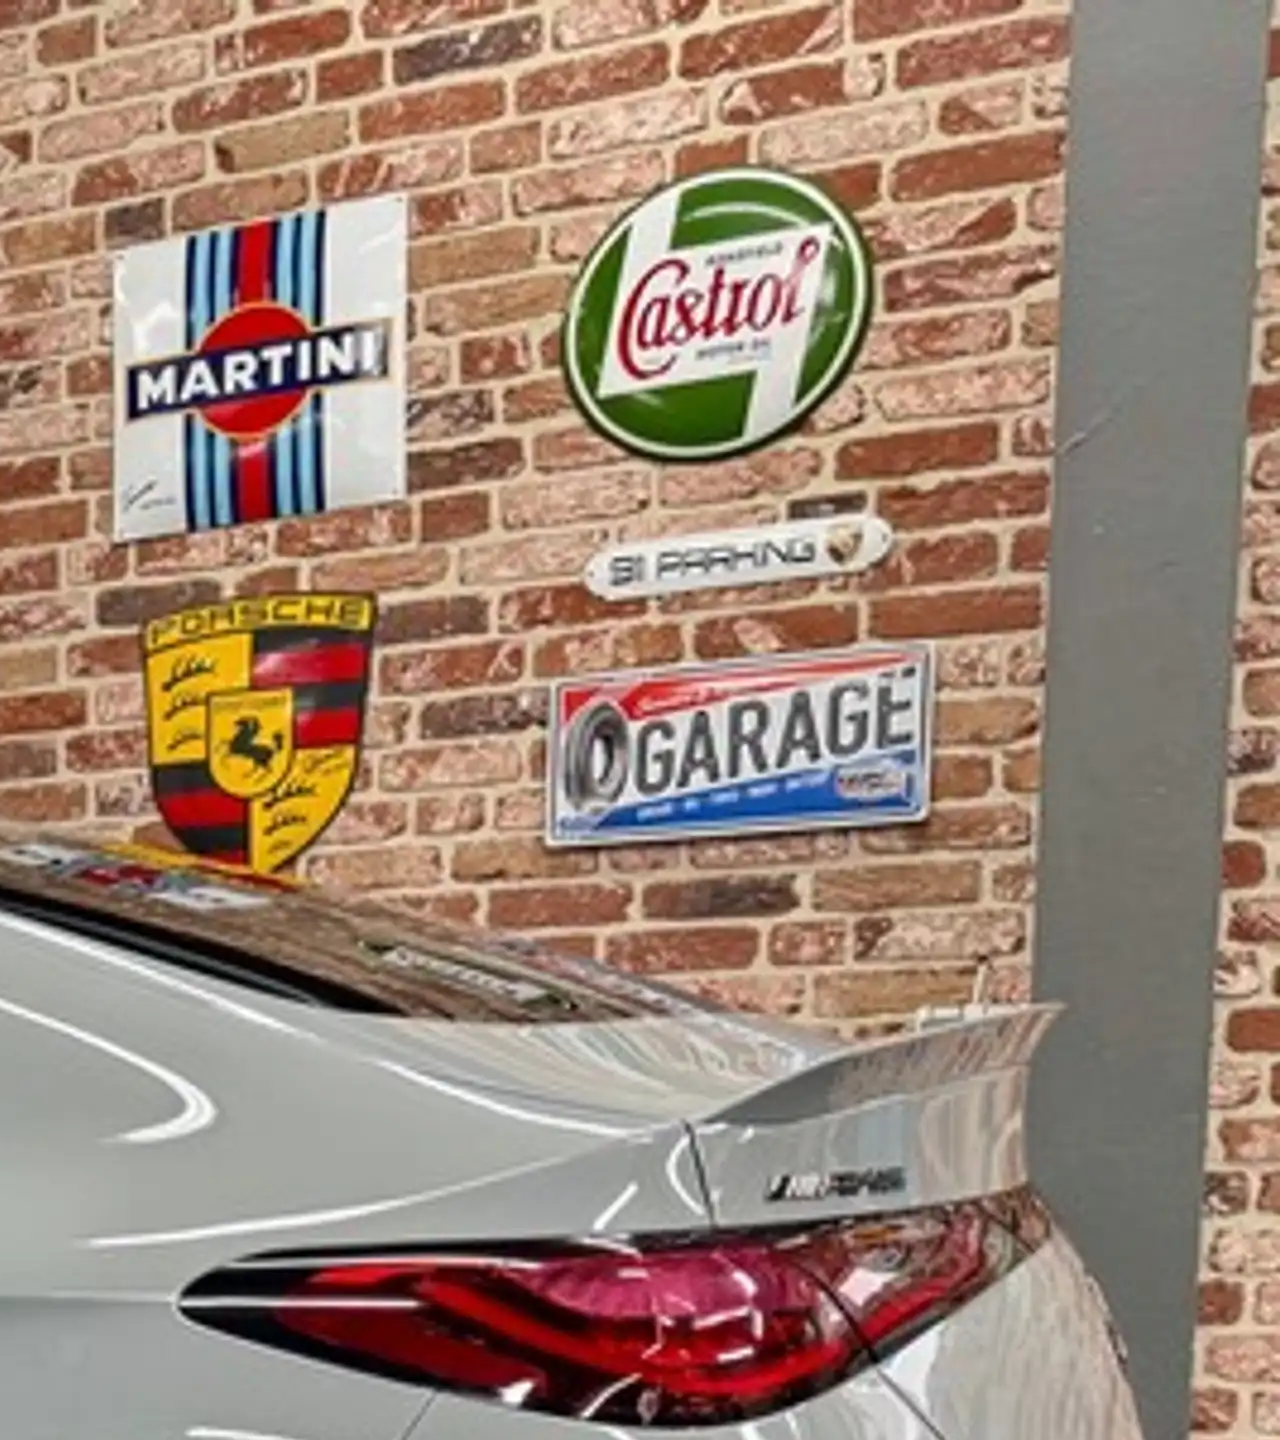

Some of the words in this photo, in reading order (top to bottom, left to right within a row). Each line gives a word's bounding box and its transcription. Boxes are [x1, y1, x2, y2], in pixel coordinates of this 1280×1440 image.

[616, 235, 821, 381] Castrol
[137, 331, 377, 410] MARTINI
[657, 536, 817, 580] PARKING
[151, 599, 362, 643] PORSCHE
[636, 665, 917, 797] GARAGE
